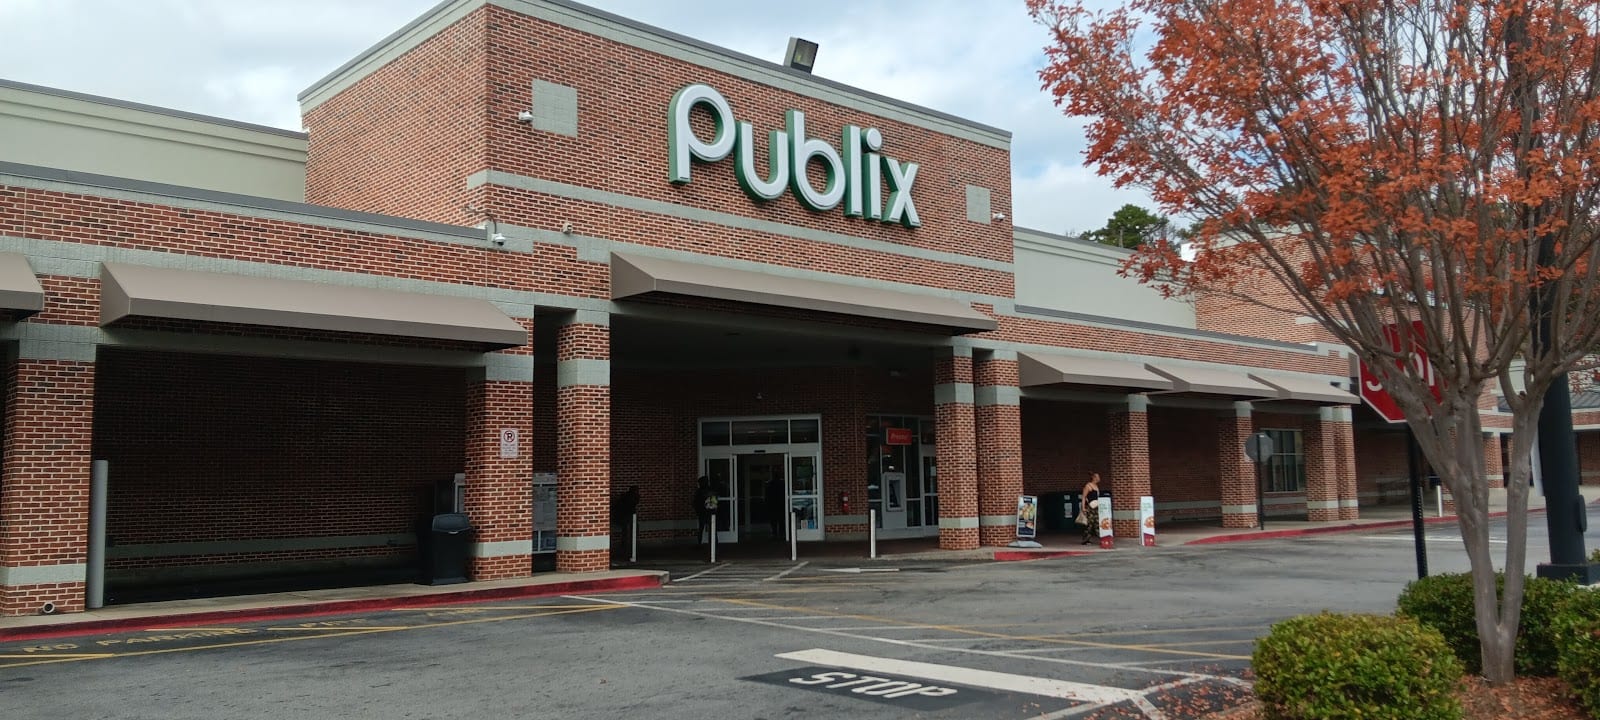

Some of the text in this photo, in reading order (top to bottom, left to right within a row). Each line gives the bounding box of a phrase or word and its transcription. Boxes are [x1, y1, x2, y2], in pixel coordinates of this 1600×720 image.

[668, 83, 921, 228] Publix
[23, 643, 79, 654] NO
[789, 672, 958, 698] STOP
